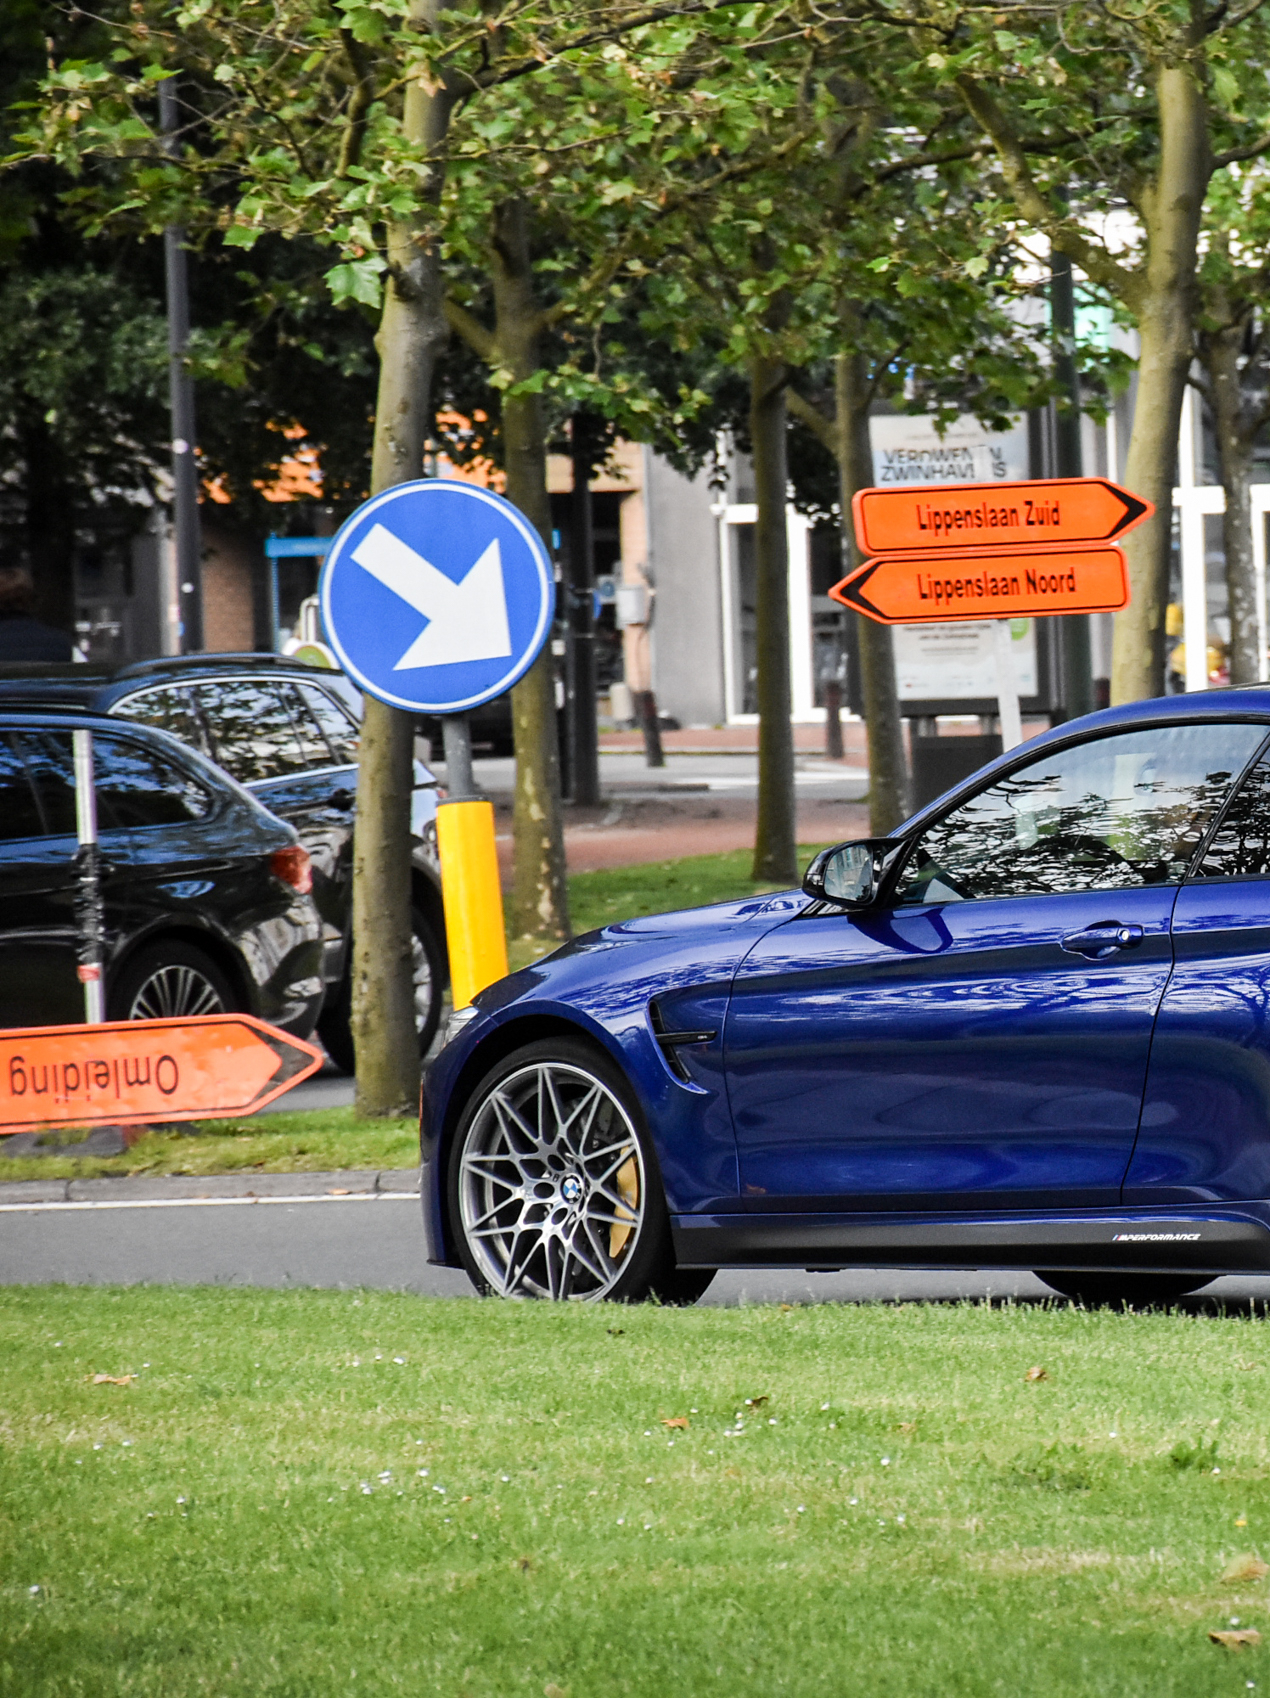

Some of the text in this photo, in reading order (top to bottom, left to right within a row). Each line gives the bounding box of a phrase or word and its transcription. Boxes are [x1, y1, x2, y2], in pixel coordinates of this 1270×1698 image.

[916, 500, 1060, 537] Lippenslaan Zuid
[917, 566, 1076, 606] Lippenslaan Noord
[9, 1055, 179, 1103] Omleiding
